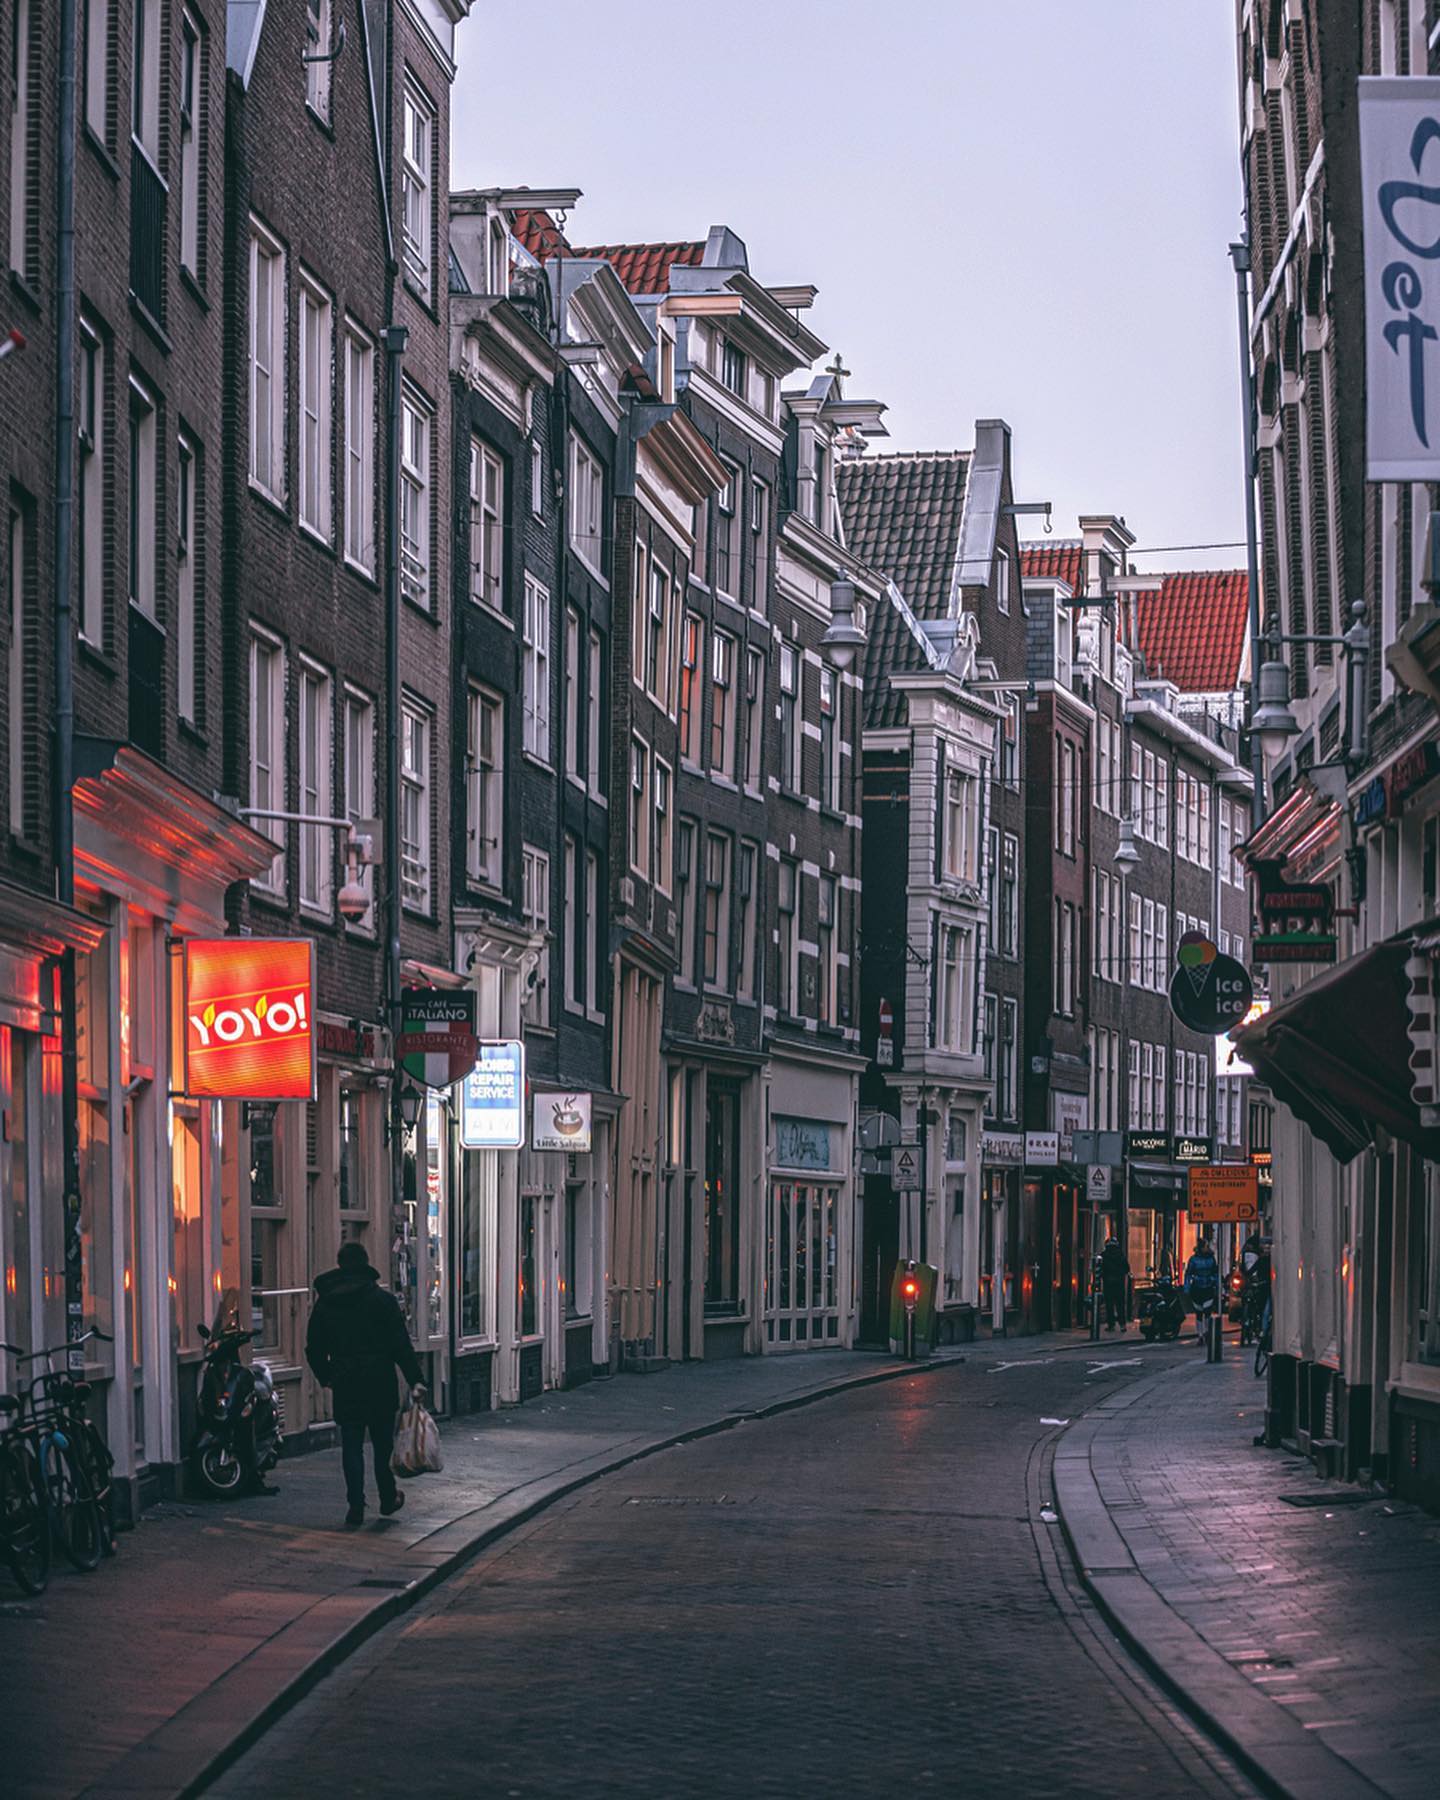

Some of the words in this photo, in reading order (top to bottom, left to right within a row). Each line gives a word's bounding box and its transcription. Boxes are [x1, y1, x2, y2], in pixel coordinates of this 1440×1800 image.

[1216, 996, 1243, 1014] ice
[189, 992, 308, 1045] YOYO!
[405, 1034, 468, 1046] RISTORANTE
[470, 1073, 515, 1086] REPAIR
[469, 1086, 515, 1099] SERVICE
